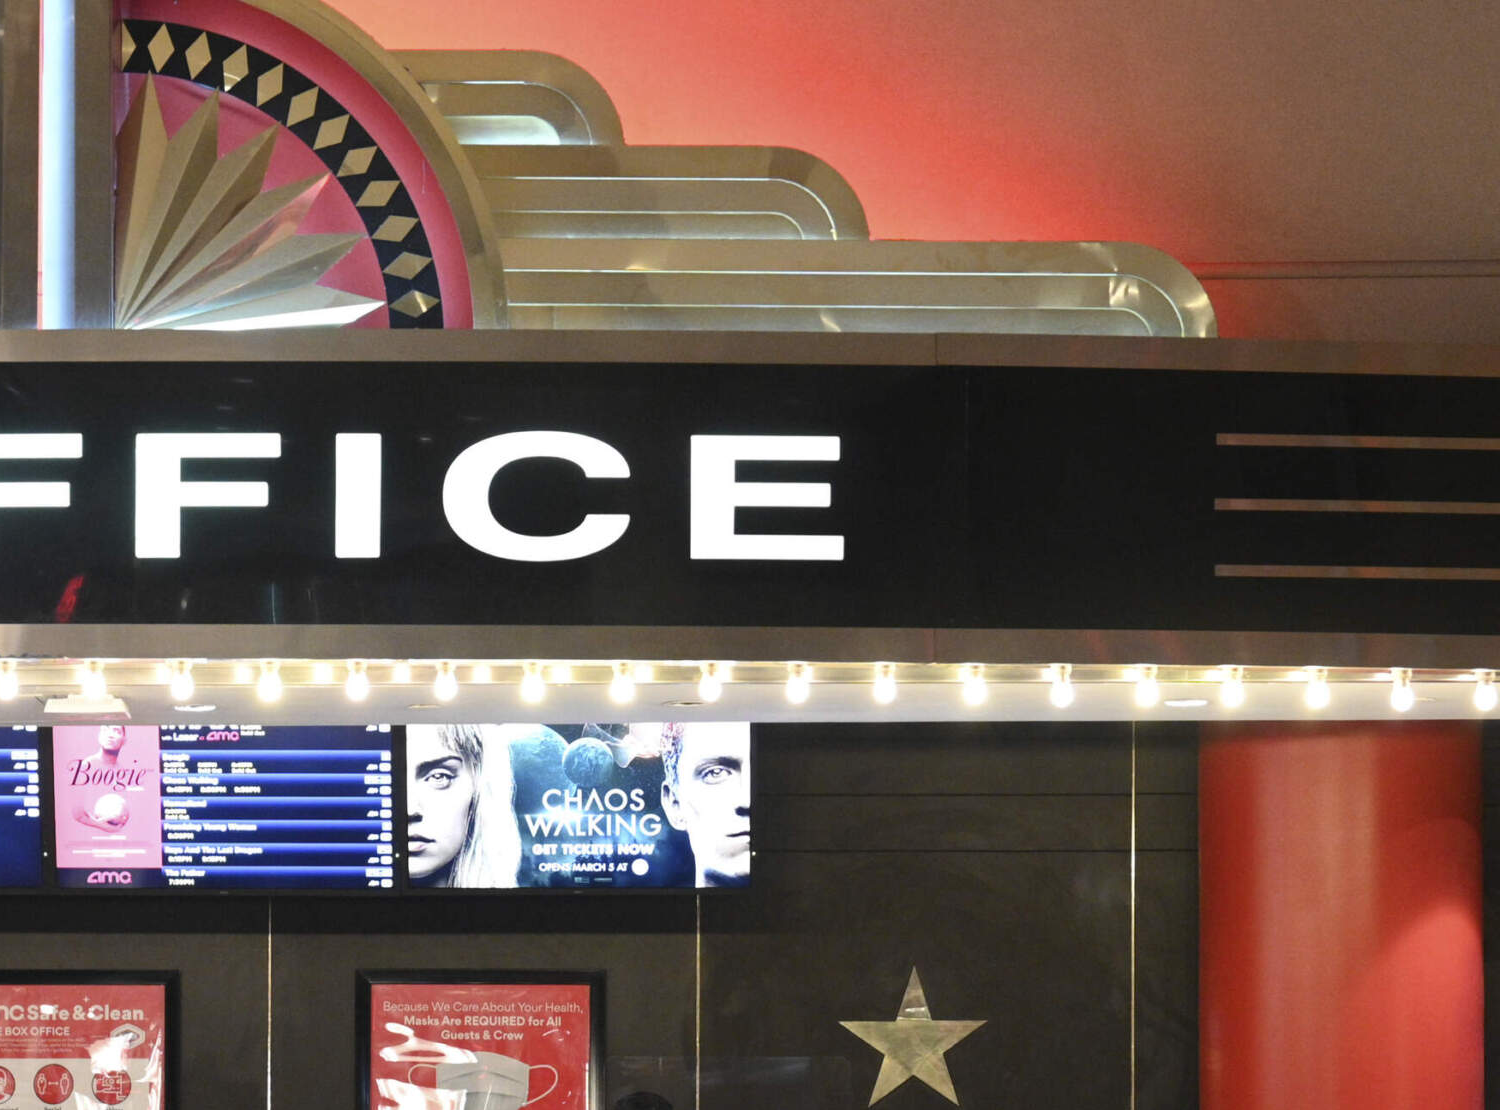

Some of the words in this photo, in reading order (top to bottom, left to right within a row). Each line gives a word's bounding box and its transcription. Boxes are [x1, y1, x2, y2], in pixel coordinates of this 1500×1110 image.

[206, 731, 240, 741] amc
[69, 759, 149, 791] Boogie
[542, 788, 645, 812] CHAOS
[524, 813, 662, 836] WALKING
[532, 844, 558, 856] GET
[561, 843, 614, 856] TICKETS
[617, 843, 656, 856] NOW
[538, 862, 572, 872] OPENS
[572, 862, 606, 872] MARCH
[607, 862, 615, 872] 5
[616, 862, 628, 872] AT
[87, 871, 132, 884] amc
[72, 1004, 86, 1021] &
[88, 1004, 144, 1021] Clean
[382, 1002, 429, 1013] Because
[431, 1002, 451, 1012] We
[452, 1002, 479, 1013] Care
[481, 1002, 515, 1012] About
[517, 1002, 543, 1012] Your
[545, 1002, 584, 1015] Health,
[404, 1016, 439, 1026] Masks
[441, 1016, 462, 1026] Are
[464, 1016, 525, 1027] REQUIRED
[527, 1016, 545, 1026] for
[546, 1016, 562, 1026] All
[4, 1027, 28, 1036] BOX
[30, 1027, 70, 1036] OFFICE
[441, 1030, 480, 1041] Guests
[482, 1030, 491, 1040] &
[493, 1031, 524, 1041] Crew
